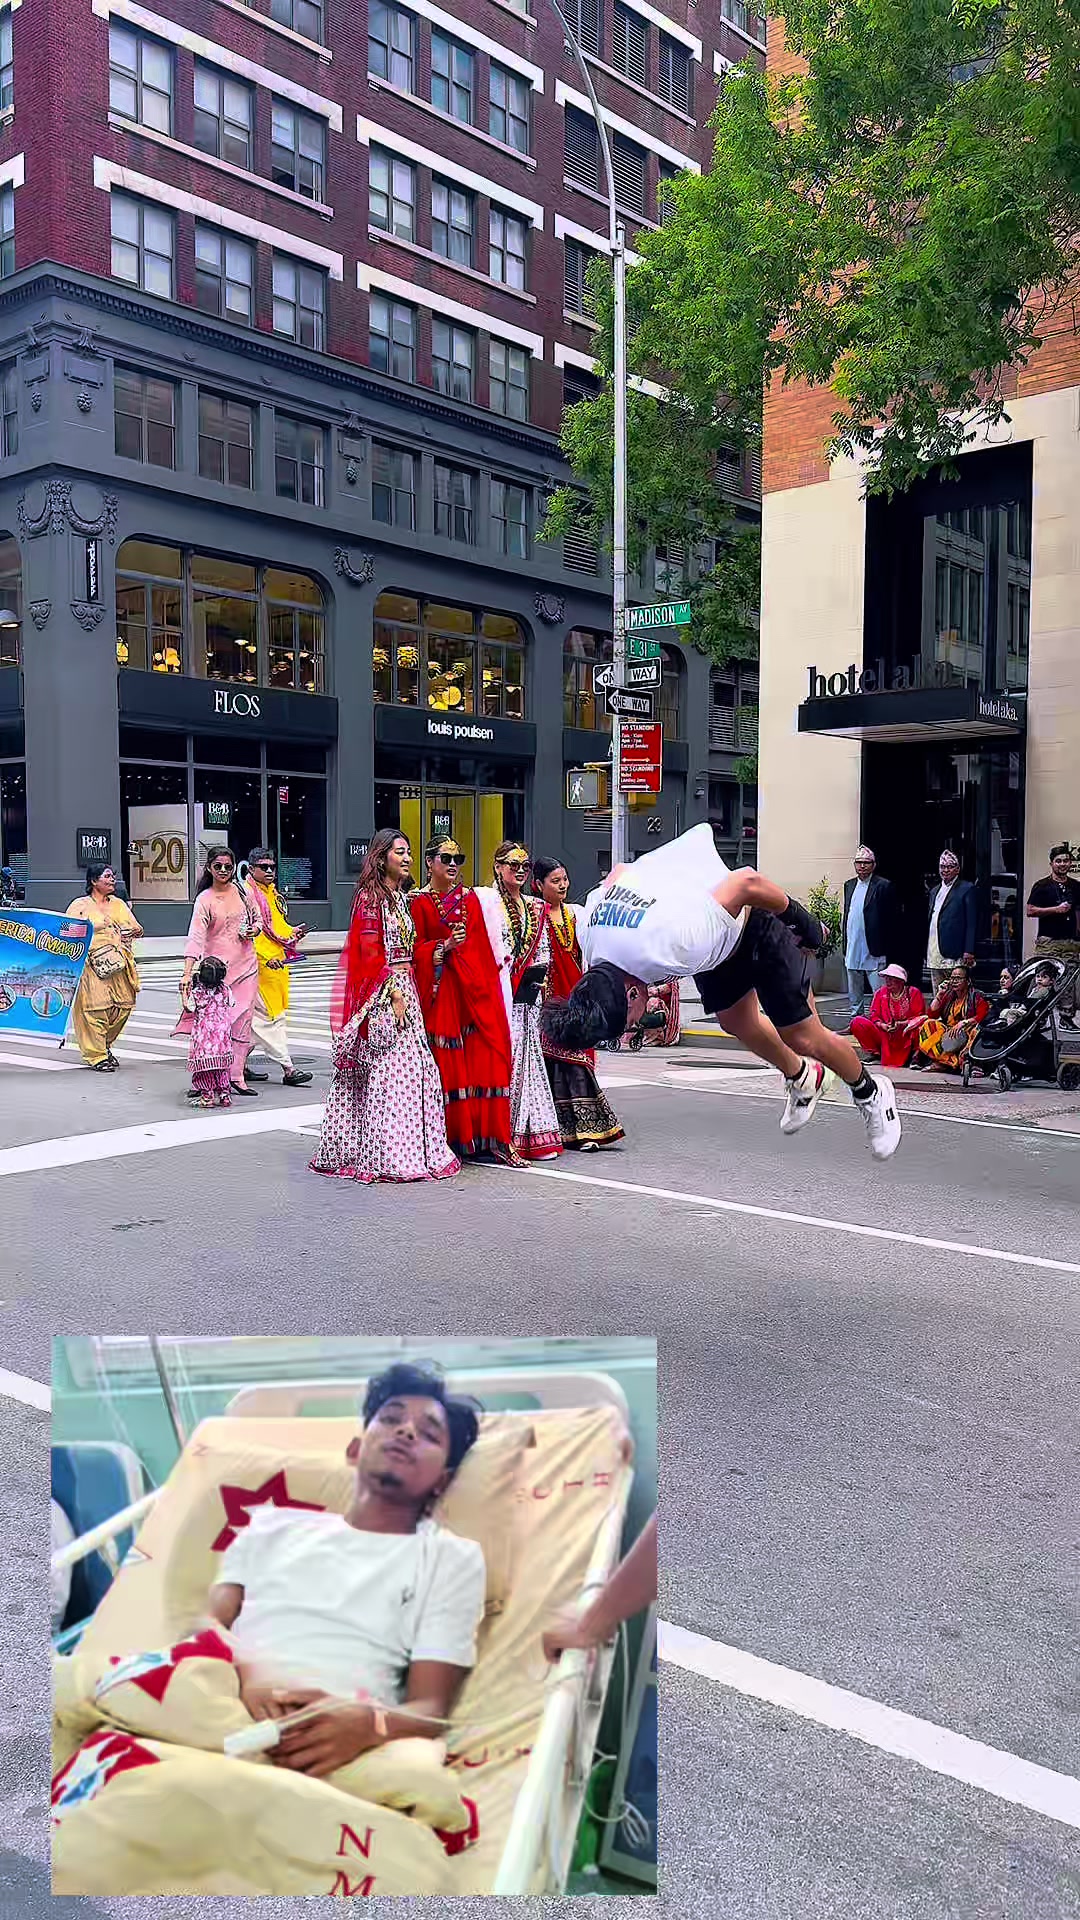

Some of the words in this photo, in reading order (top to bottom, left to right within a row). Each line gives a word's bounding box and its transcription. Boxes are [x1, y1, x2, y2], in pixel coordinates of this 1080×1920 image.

[630, 605, 676, 627] MADISON
[680, 604, 688, 613] AV
[630, 639, 635, 655] E
[639, 641, 647, 657] 31
[650, 644, 656, 652] ST
[602, 672, 615, 684] ON
[632, 667, 655, 681] WAY
[806, 658, 886, 699] hotel
[214, 689, 261, 718] FLOS
[612, 695, 626, 708] ONE
[632, 698, 648, 711] WAY
[428, 719, 453, 736] louis
[454, 724, 494, 740] poulsen
[208, 802, 230, 815] B&B
[82, 835, 107, 848] B&B
[350, 844, 368, 856] B&B
